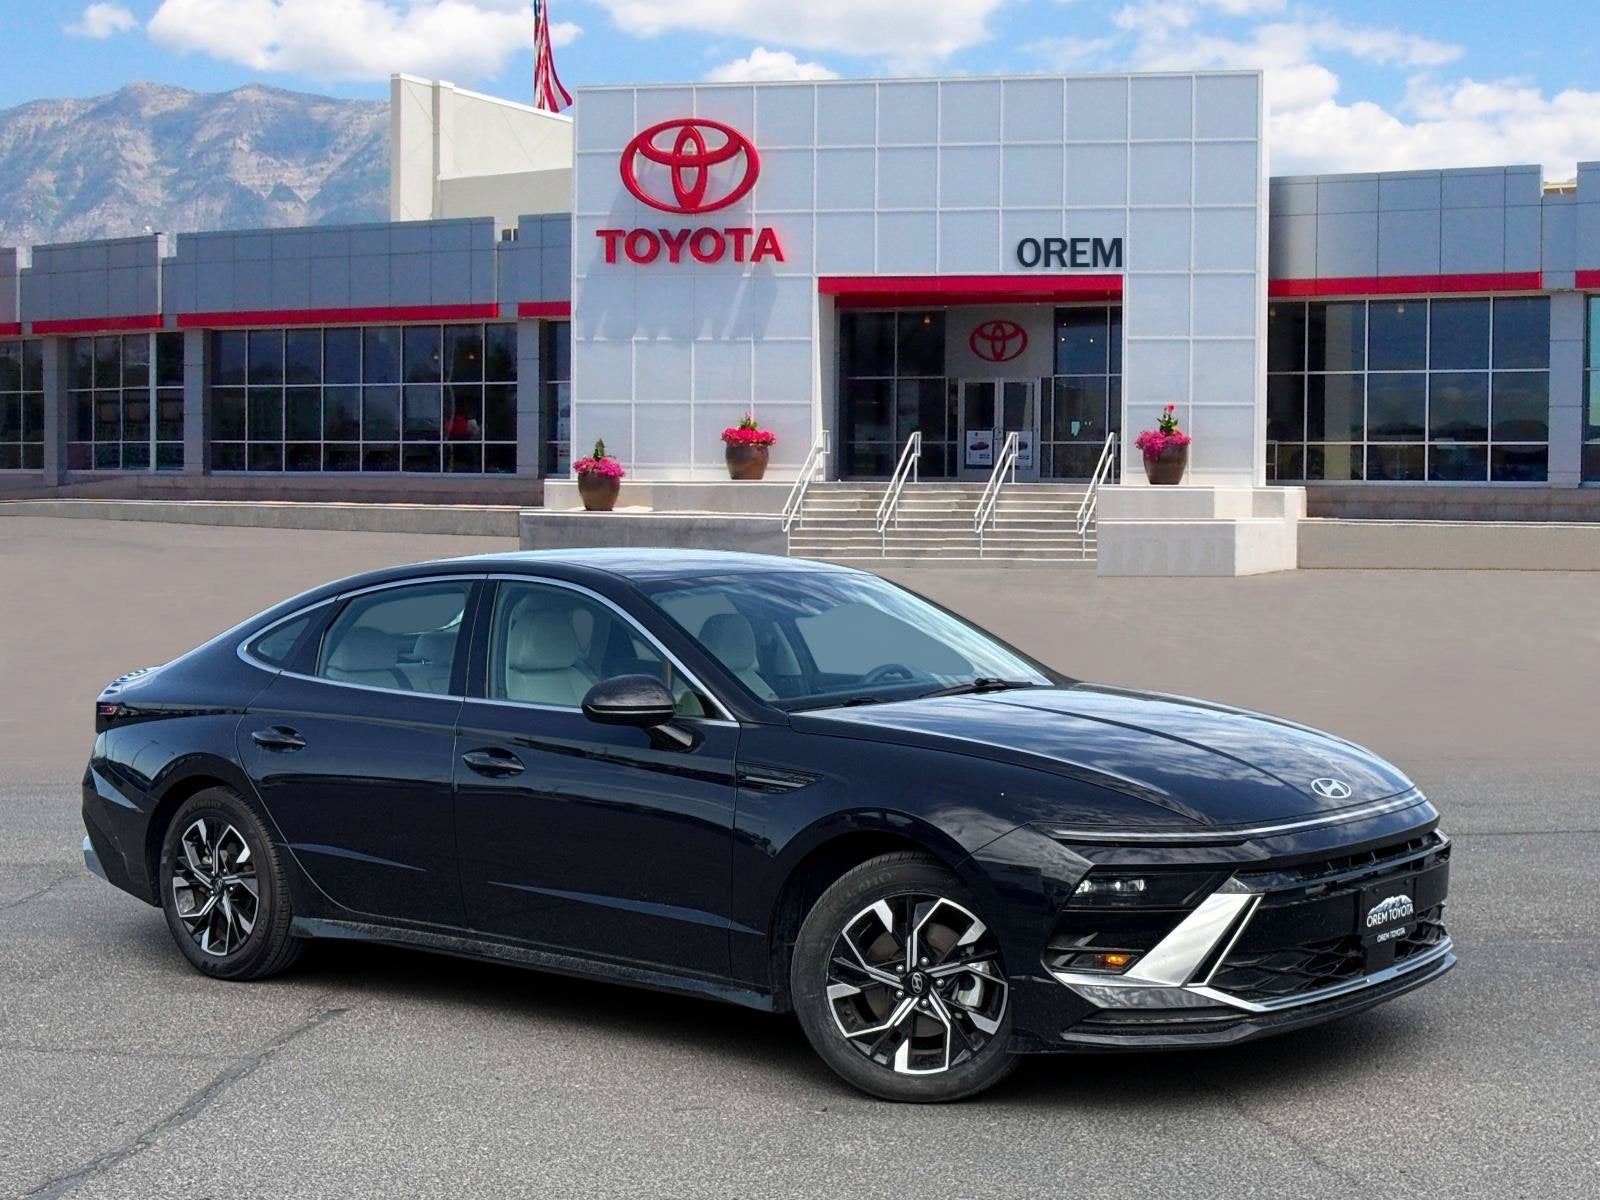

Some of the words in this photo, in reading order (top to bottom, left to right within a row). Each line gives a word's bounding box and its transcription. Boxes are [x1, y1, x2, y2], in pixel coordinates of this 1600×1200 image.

[596, 227, 785, 264] TOYOTA
[1017, 237, 1123, 268] OREM
[1366, 911, 1388, 928] OREM
[1388, 903, 1414, 921] TOYOTA
[1376, 932, 1390, 943] OREM
[1390, 927, 1406, 939] TOYOTA
